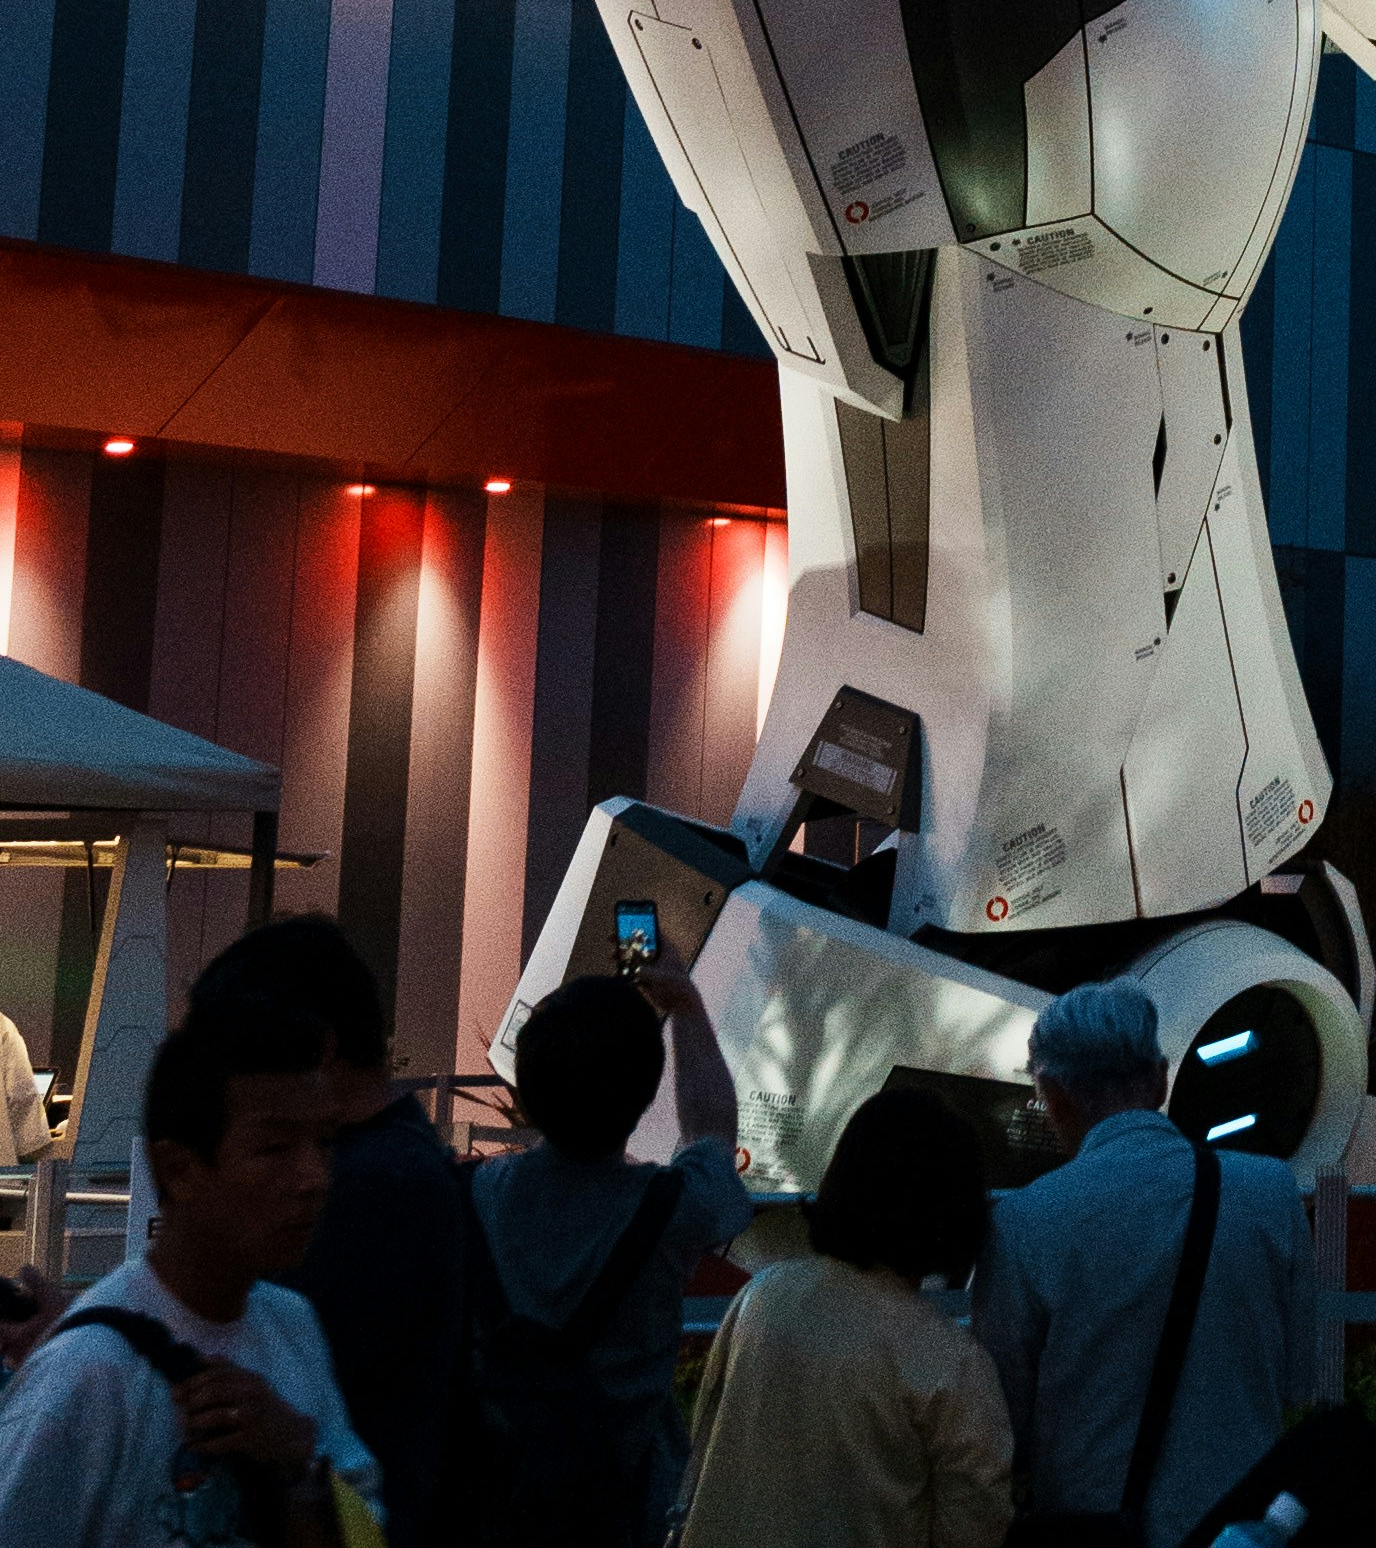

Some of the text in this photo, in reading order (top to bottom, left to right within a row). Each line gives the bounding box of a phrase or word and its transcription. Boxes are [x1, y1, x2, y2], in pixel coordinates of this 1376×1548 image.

[838, 132, 886, 160] CAUTION
[1026, 228, 1075, 246] CAUTION
[1249, 775, 1281, 810] CAUTION
[1002, 822, 1046, 852] CAUTION
[749, 1090, 797, 1107] CAUTION
